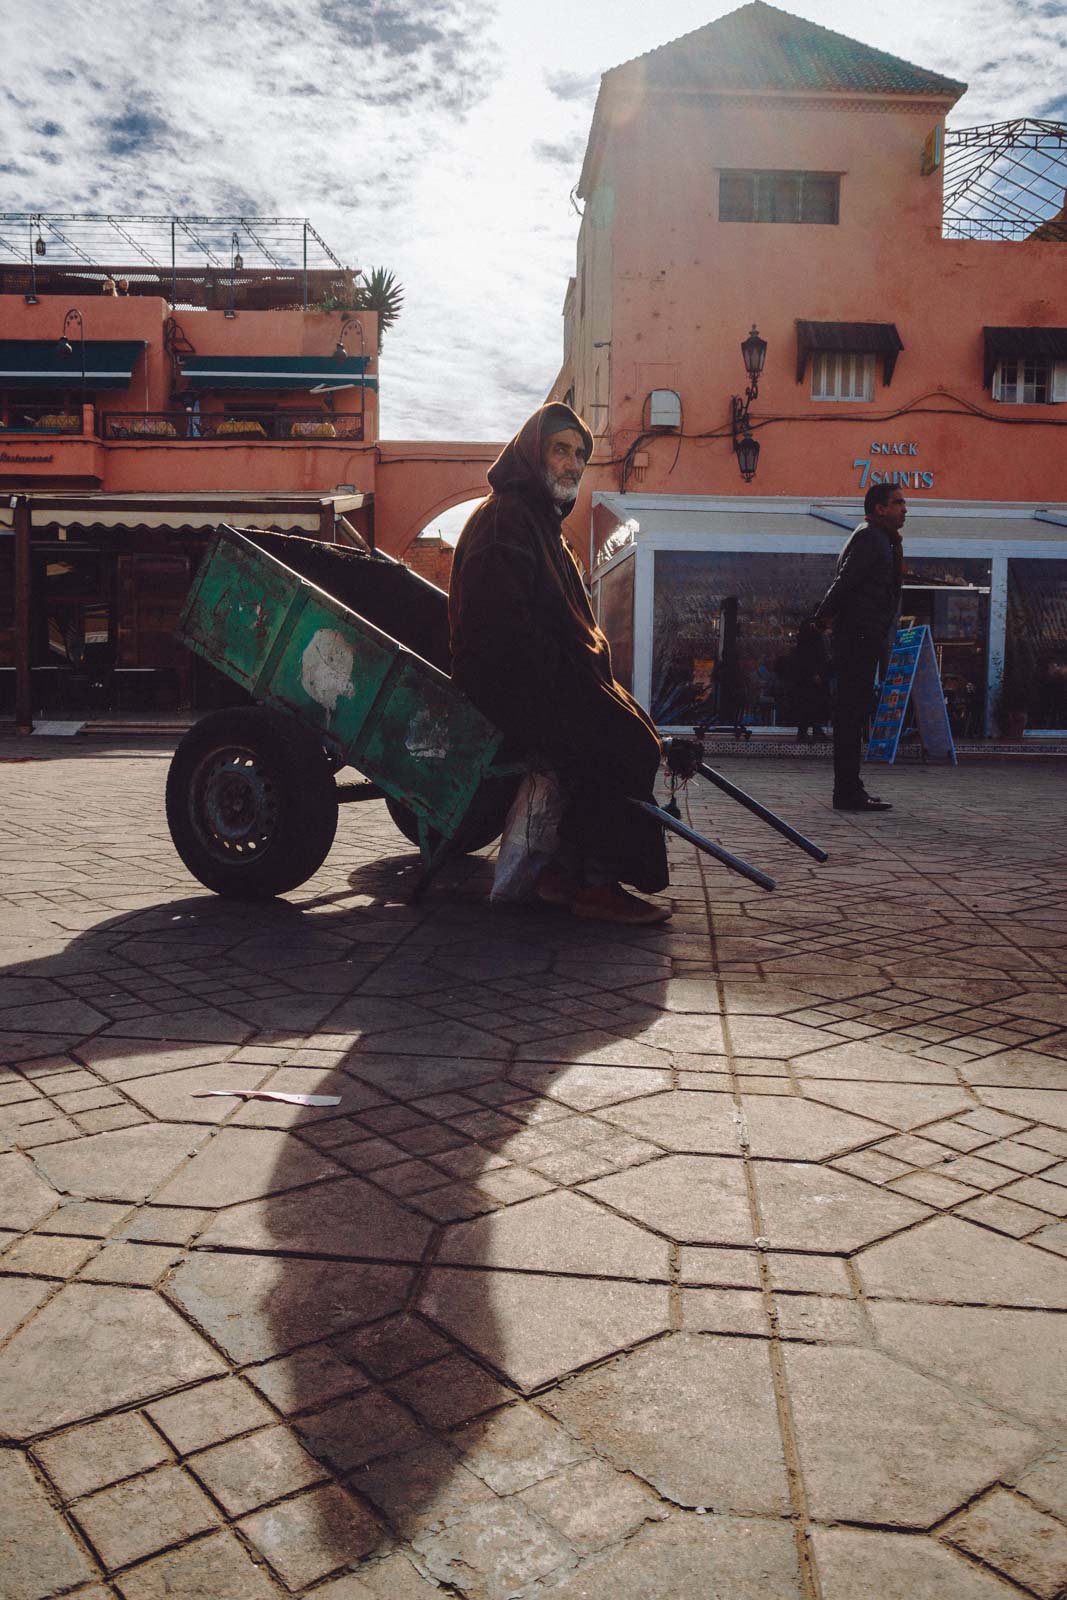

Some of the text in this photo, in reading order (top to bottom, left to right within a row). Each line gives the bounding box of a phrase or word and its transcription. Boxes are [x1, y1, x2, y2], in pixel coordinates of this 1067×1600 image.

[871, 442, 918, 456] SNACK
[853, 459, 934, 489] 7 SAINTS
